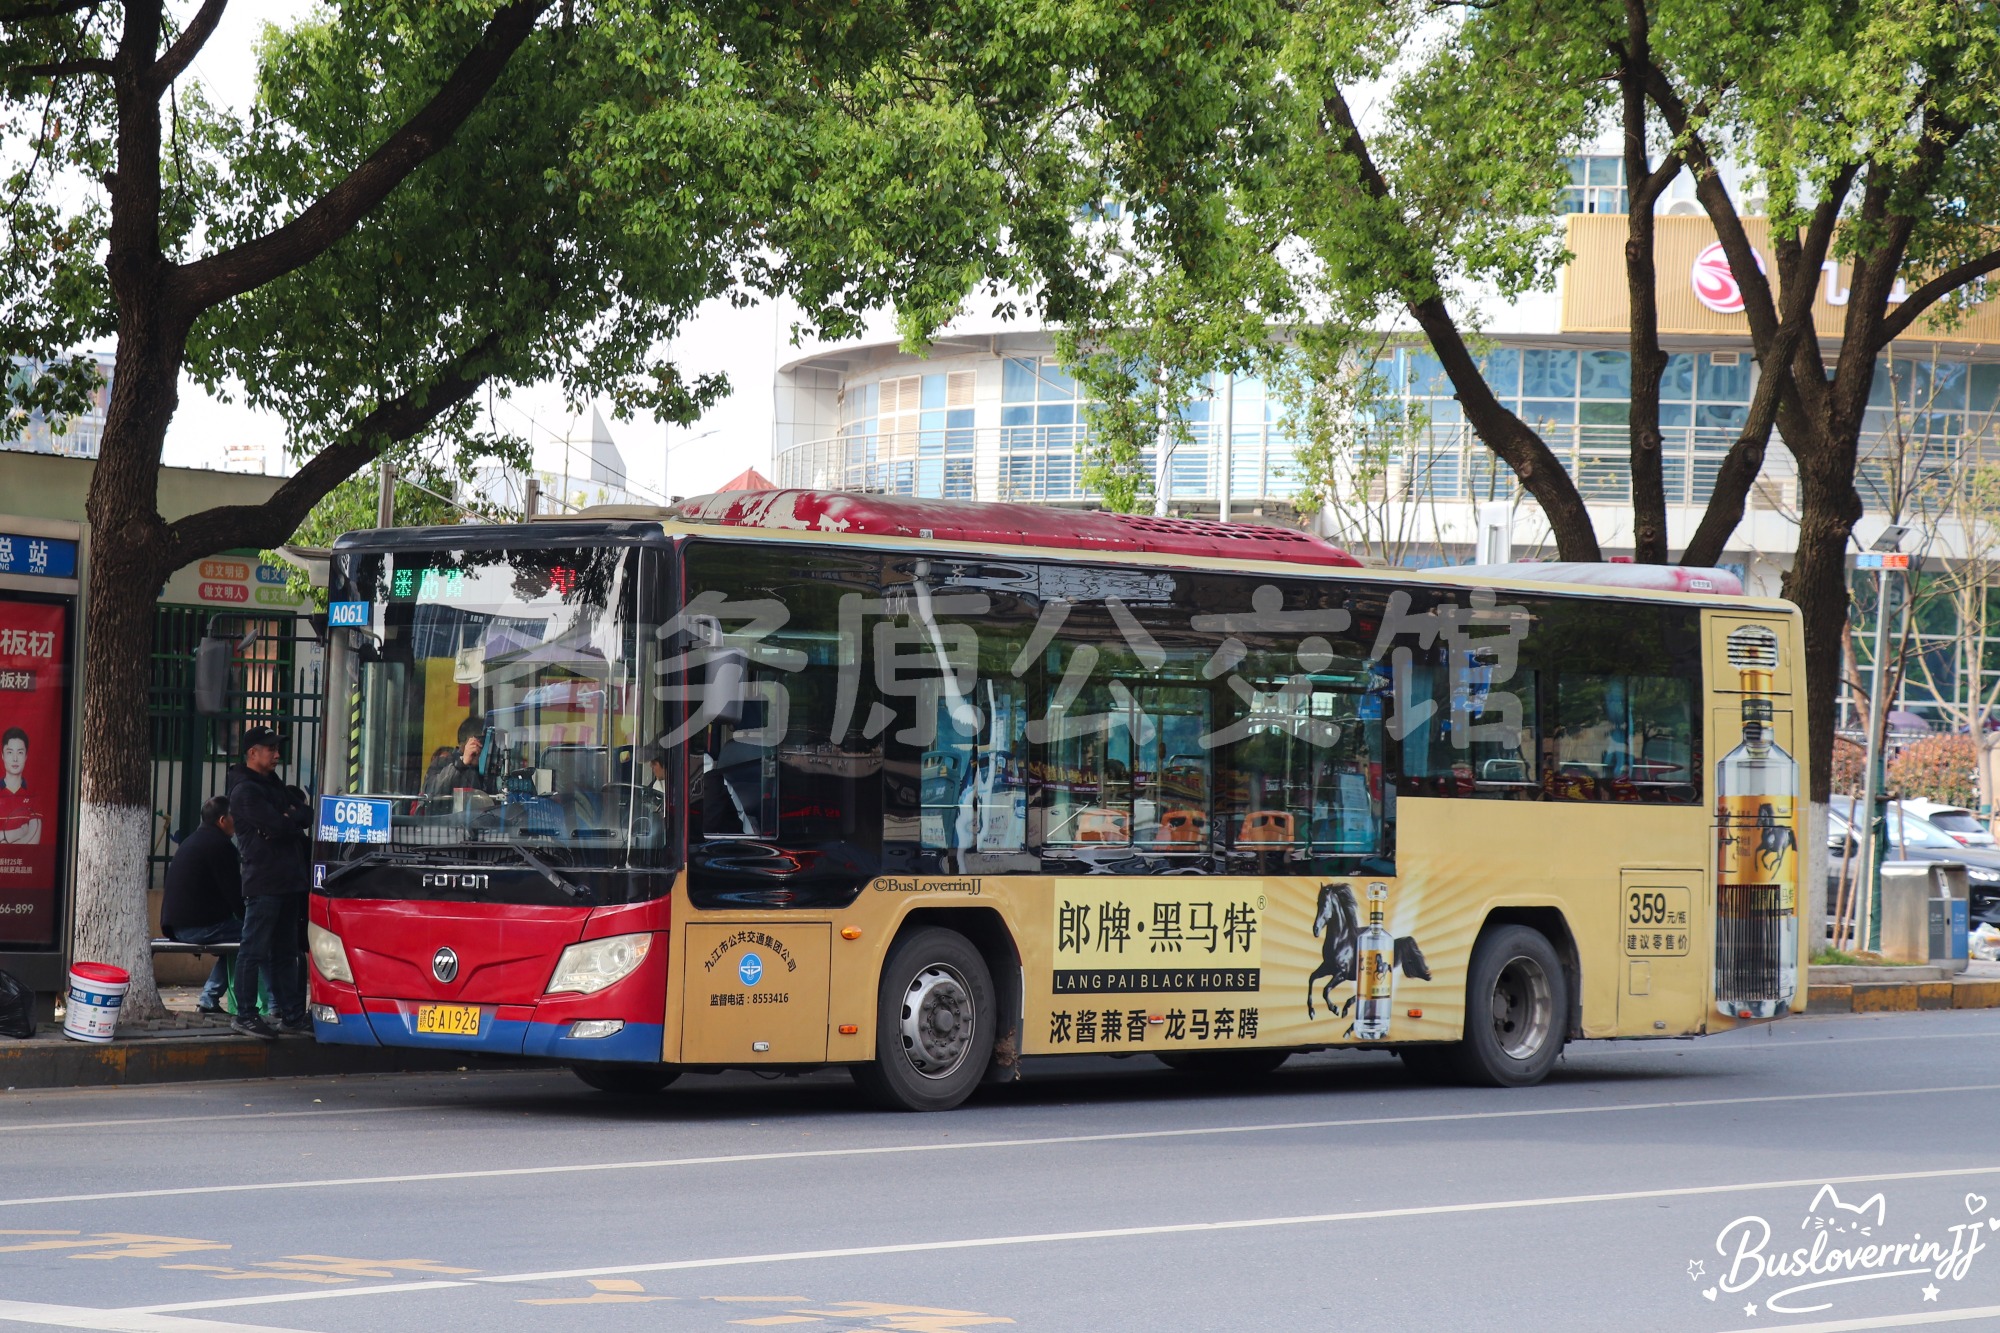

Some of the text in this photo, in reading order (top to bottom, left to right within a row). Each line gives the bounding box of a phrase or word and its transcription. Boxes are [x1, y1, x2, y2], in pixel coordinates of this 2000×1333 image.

[30, 565, 44, 574] ZAN
[205, 563, 244, 578] 讲文明话
[204, 584, 243, 599] 做文明人
[332, 604, 363, 624] A061
[0, 629, 56, 658] 板材
[0, 671, 30, 689] 板材
[335, 801, 373, 827] 66路
[422, 873, 489, 889] FOTON
[1627, 934, 1688, 950] 建议零售价
[704, 930, 797, 973] 九江市公共交通集团公司
[1056, 972, 1256, 989] LANG PAI BLACK HORSE
